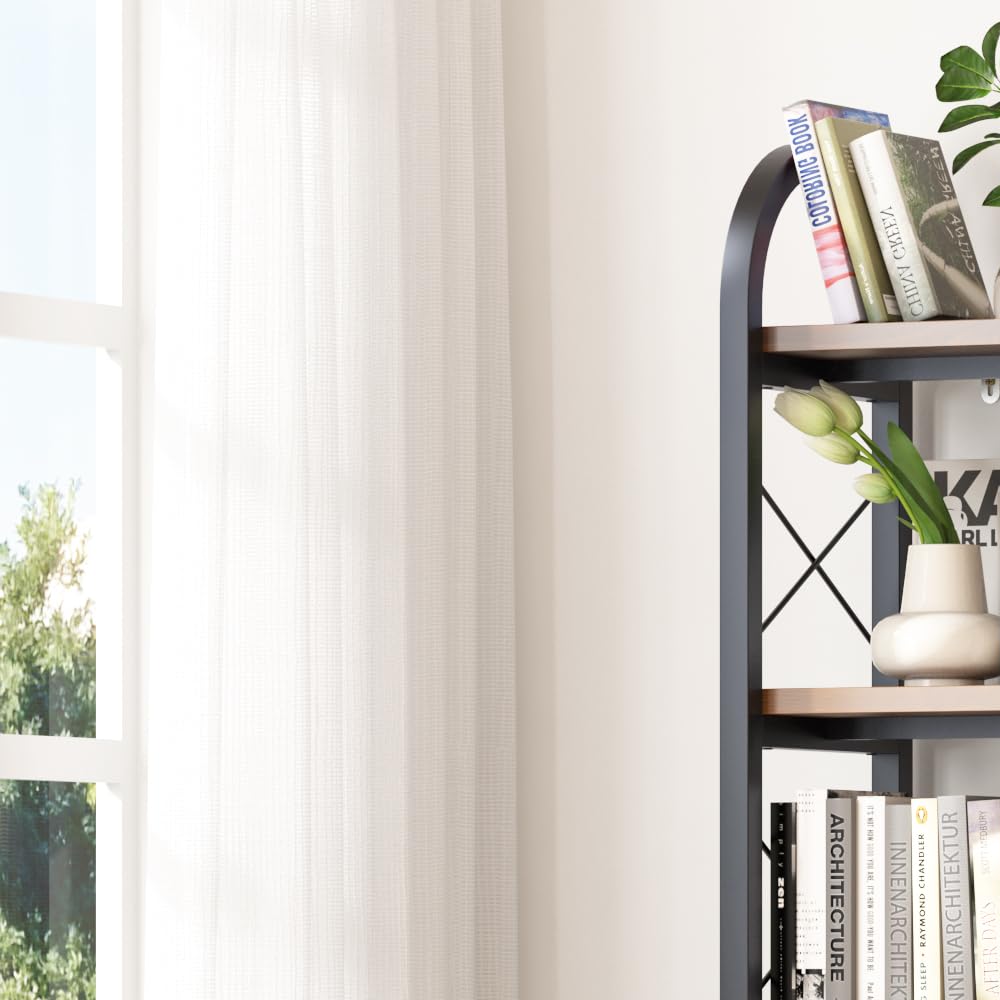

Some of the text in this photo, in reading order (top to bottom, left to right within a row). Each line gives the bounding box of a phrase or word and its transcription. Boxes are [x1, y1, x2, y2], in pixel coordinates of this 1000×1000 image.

[777, 877, 785, 909] zen
[830, 814, 845, 982] ARCHITECTURE
[980, 902, 1000, 994] AFTER DAYS
